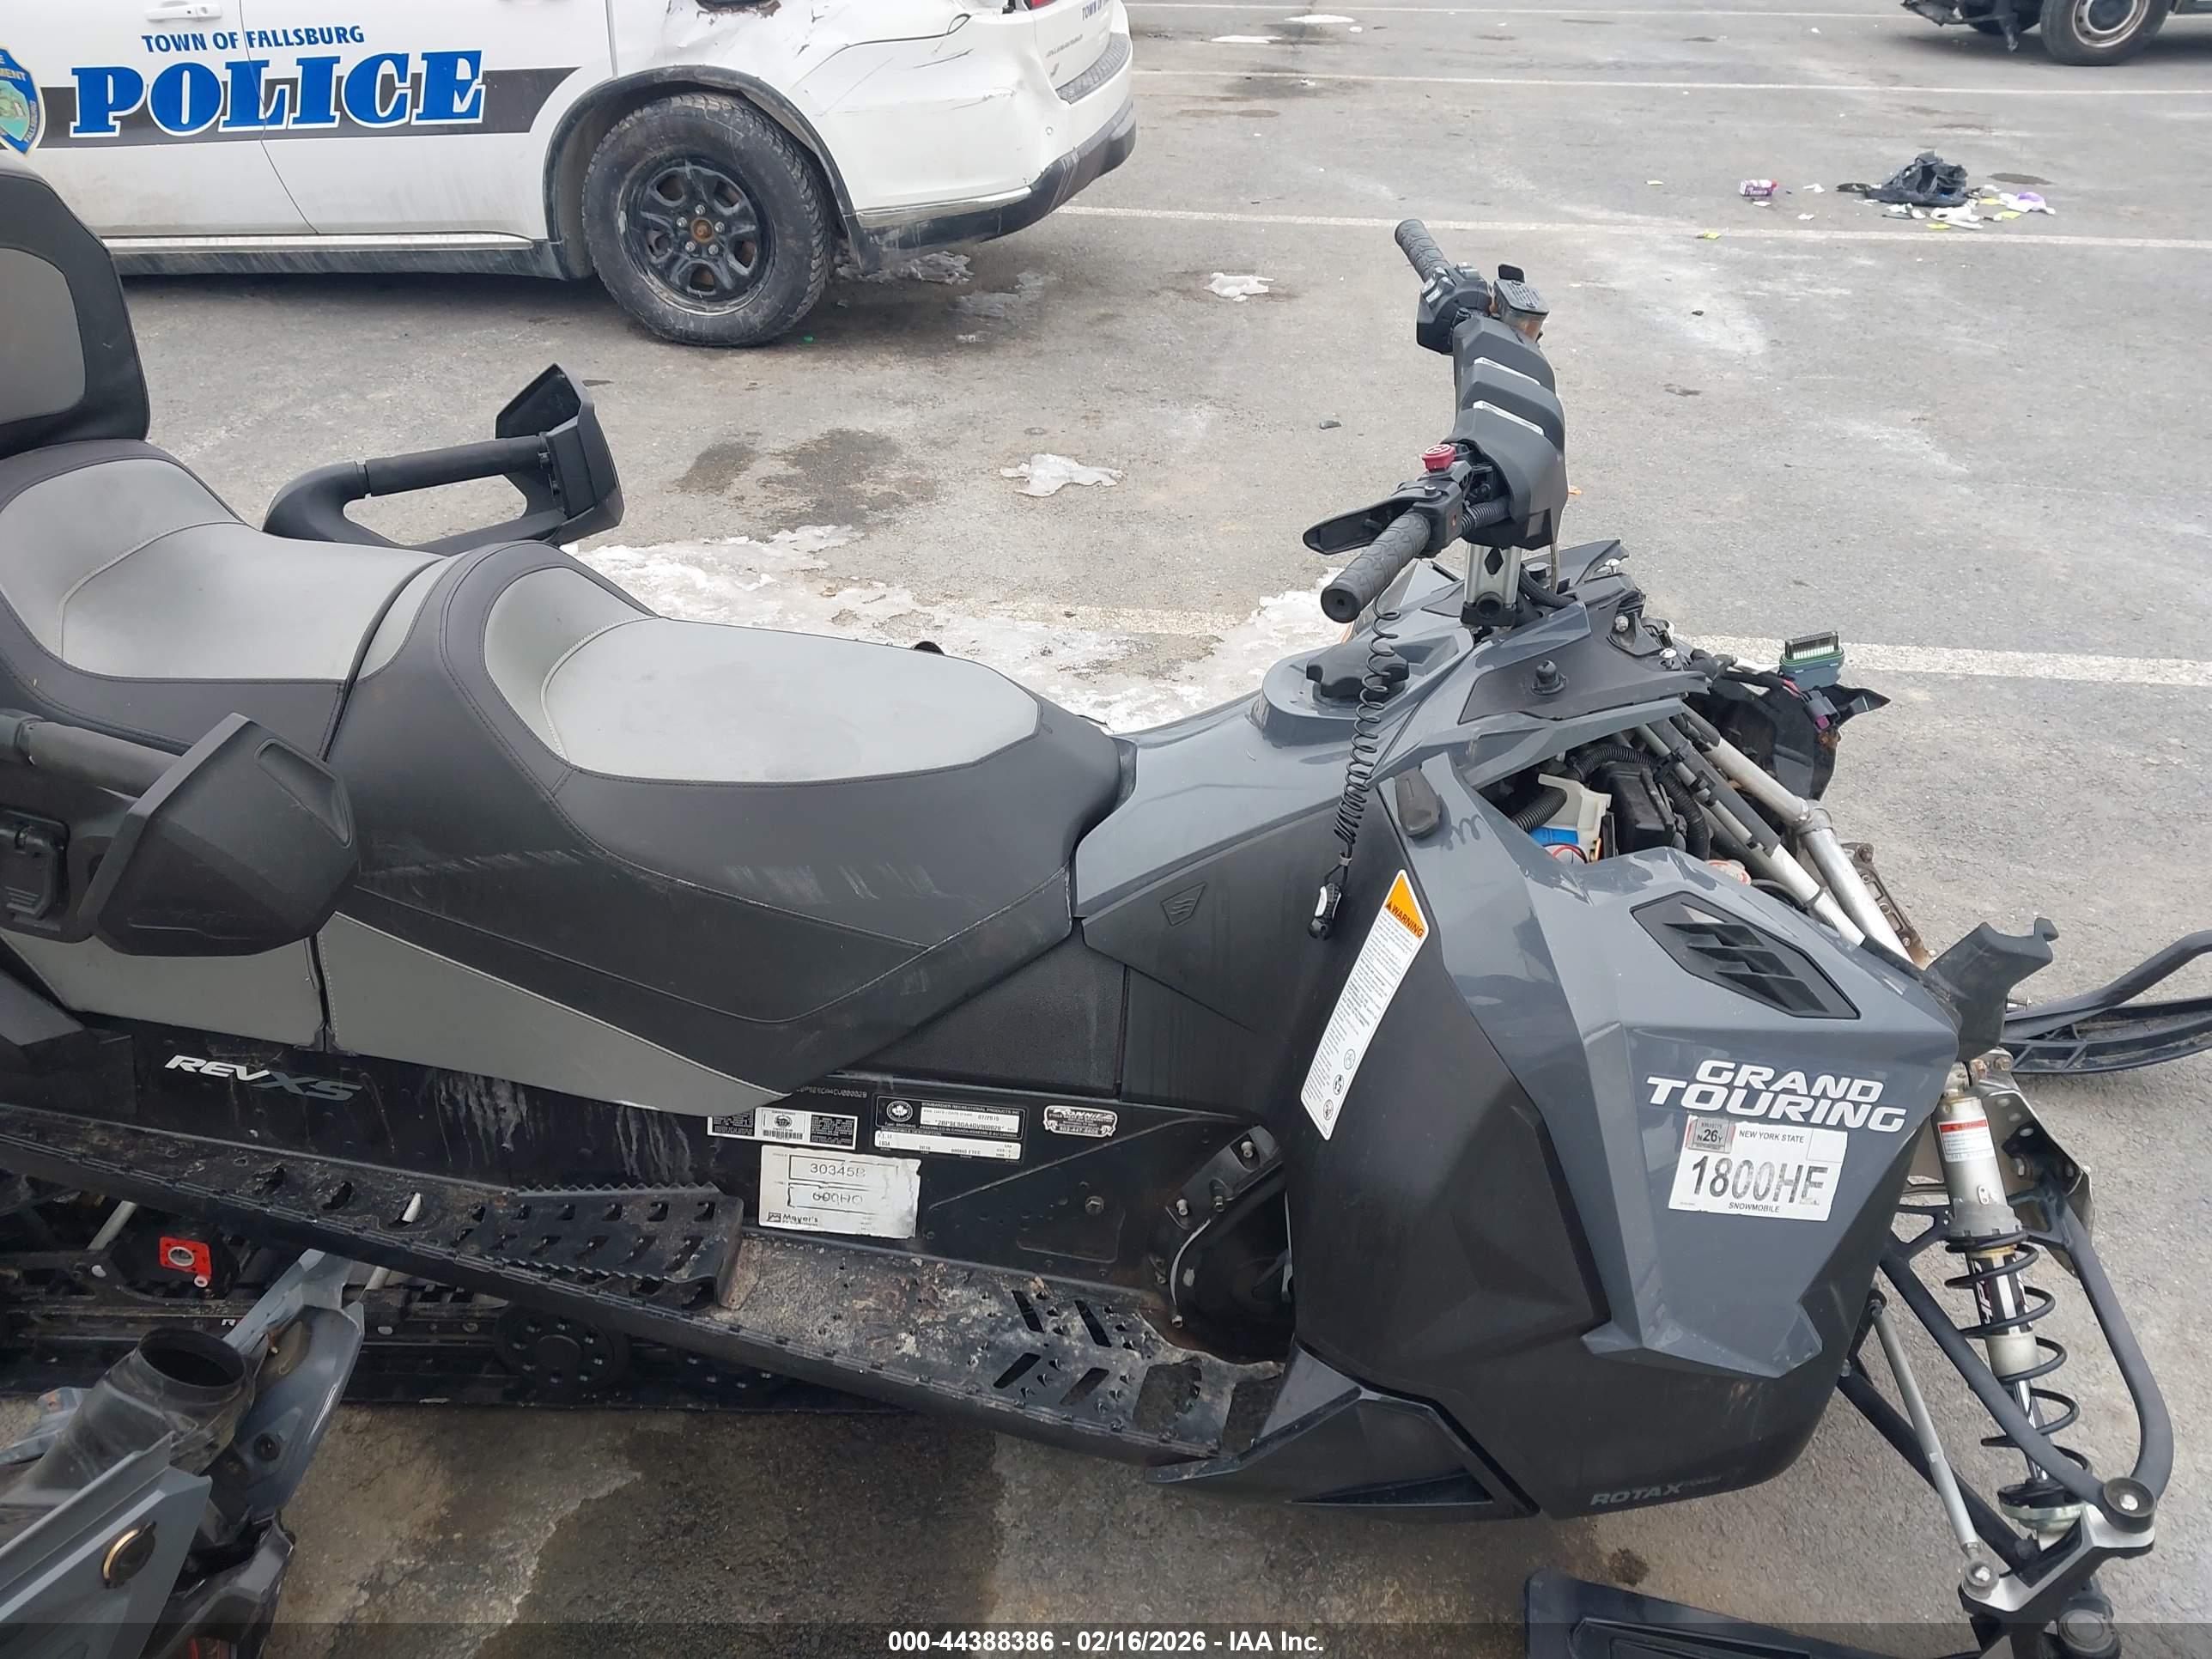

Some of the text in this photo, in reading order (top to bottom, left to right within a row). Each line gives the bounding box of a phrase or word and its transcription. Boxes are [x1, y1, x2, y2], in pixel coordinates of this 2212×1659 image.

[142, 26, 365, 53] TOWN OF FALLSBURG
[70, 50, 486, 137] POLICE
[1392, 904, 1425, 938] WARNING
[1695, 1060, 1884, 1103] GRAND
[1646, 1076, 1907, 1133] TOURING
[1739, 1130, 1805, 1144] NEW YORK STATE
[1729, 1201, 1780, 1213] SNOWMOBILE
[1590, 1484, 1684, 1505] ROTAX
